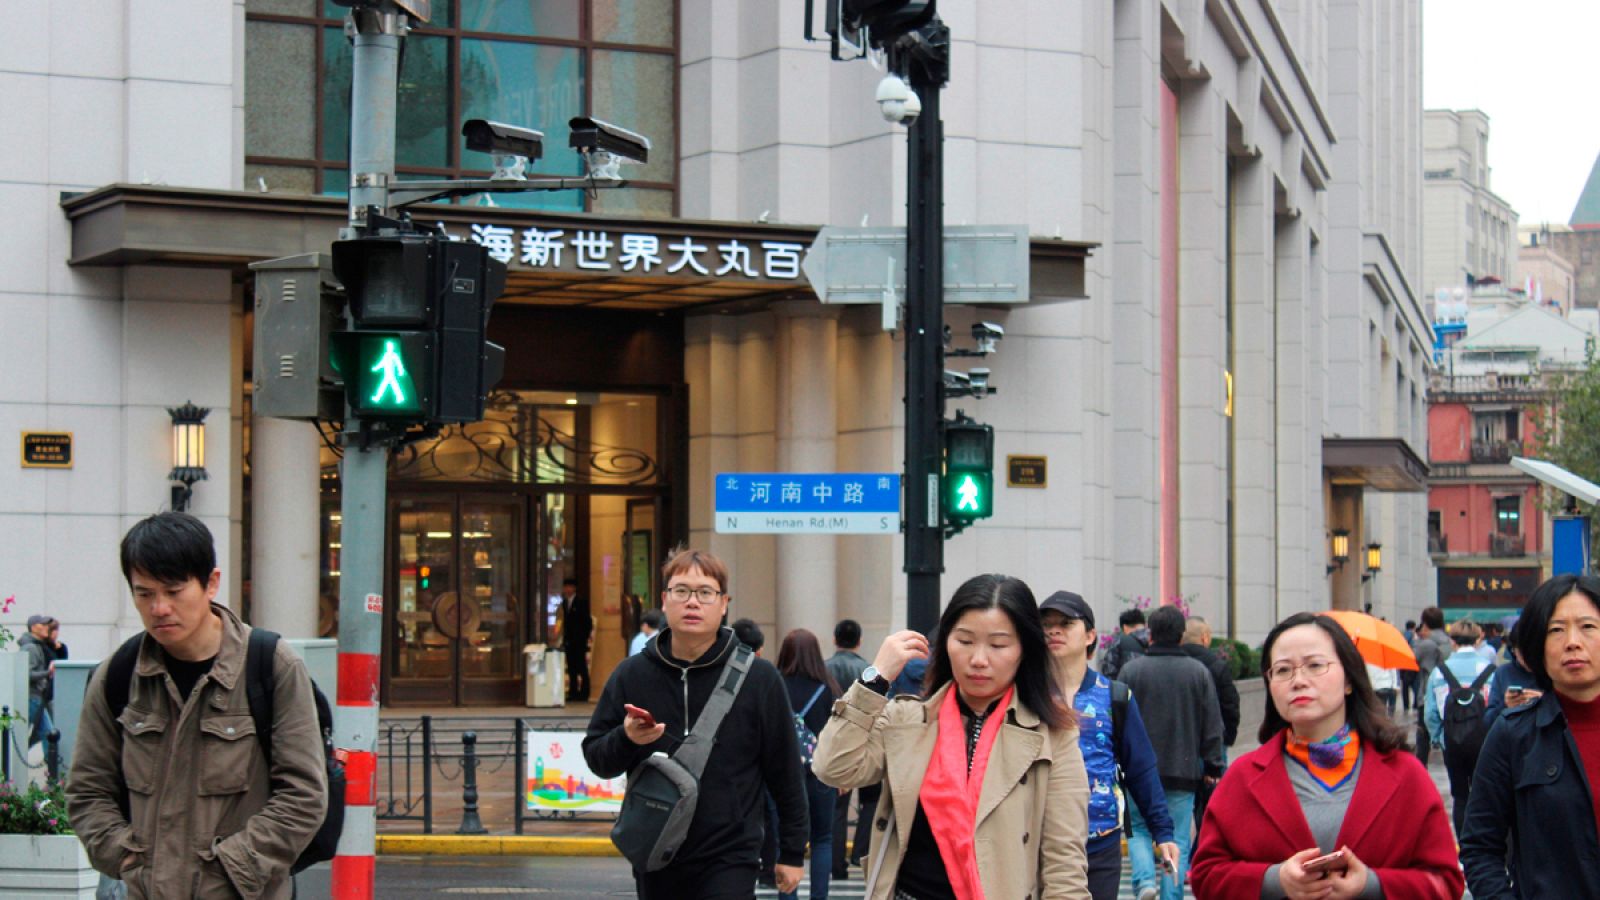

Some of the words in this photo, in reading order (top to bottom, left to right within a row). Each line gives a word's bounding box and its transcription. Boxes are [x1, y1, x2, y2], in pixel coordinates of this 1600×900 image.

[437, 222, 809, 278] 海新世界大丸百
[726, 478, 739, 490] 北
[750, 482, 864, 504] 河南中路
[878, 477, 890, 490] 南
[727, 517, 737, 529] N
[766, 517, 804, 528] Henan
[810, 517, 848, 530] Rd.(M)
[881, 517, 888, 529] S
